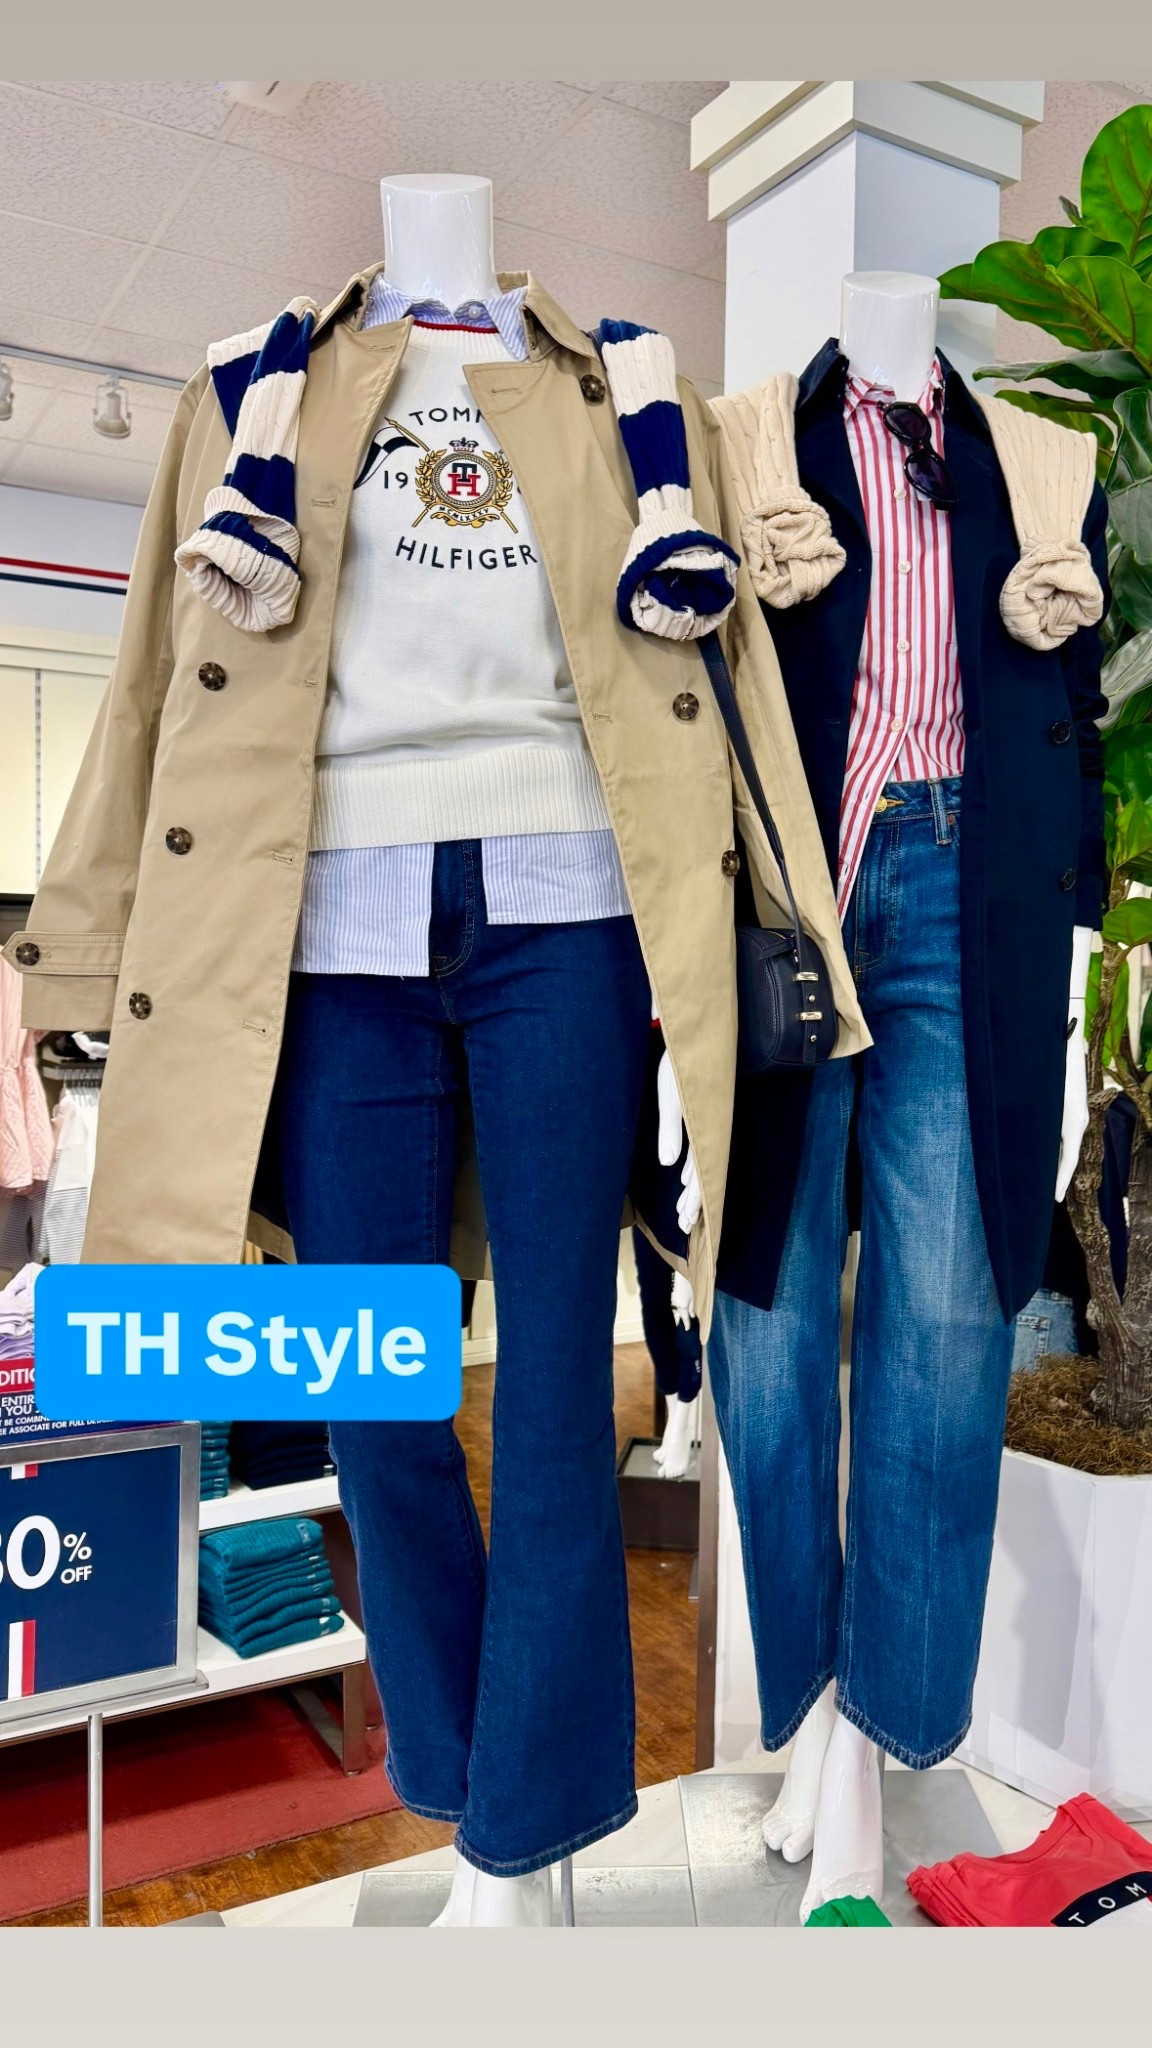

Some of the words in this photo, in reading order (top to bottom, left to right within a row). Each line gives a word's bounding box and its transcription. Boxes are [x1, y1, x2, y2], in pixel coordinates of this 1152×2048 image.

[383, 470, 409, 490] 19
[438, 506, 490, 522] MCMLXXXV
[395, 536, 538, 570] HILFIGER
[6, 1404, 32, 1417] YOU
[9, 1423, 50, 1434] ASSOCIATE
[52, 1421, 67, 1429] FOR
[60, 1565, 93, 1585] OFF
[1067, 1882, 1147, 1925] TOM
